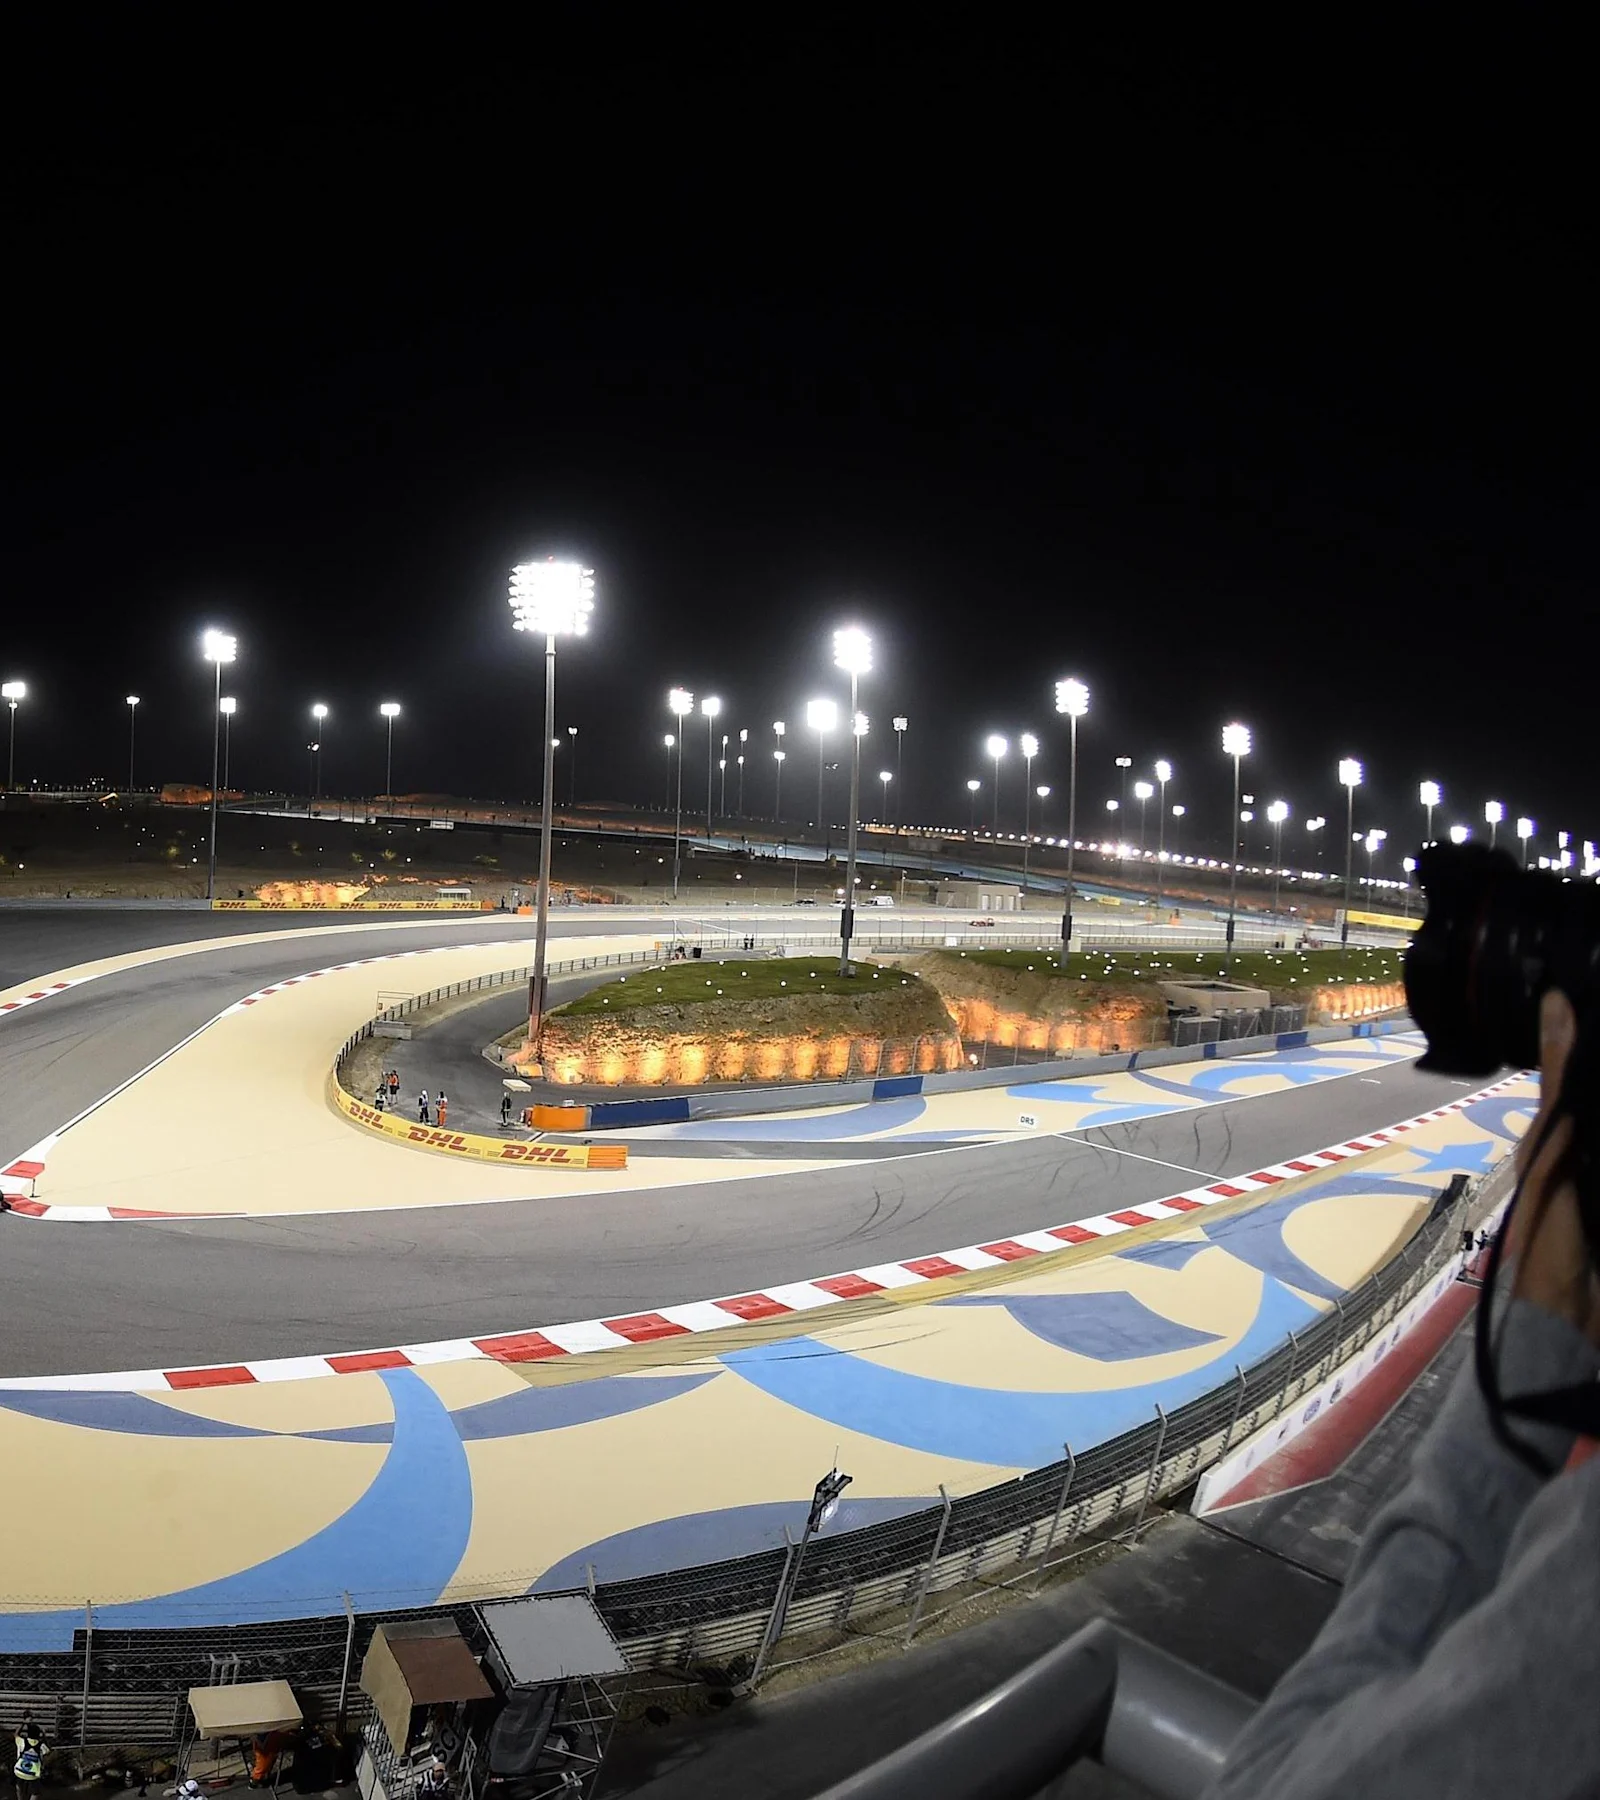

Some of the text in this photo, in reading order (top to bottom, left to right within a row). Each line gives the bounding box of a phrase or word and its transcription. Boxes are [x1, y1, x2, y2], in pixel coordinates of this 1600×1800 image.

[348, 1101, 572, 1164] DHL DHL DHL
[1020, 1115, 1035, 1126] DRS
